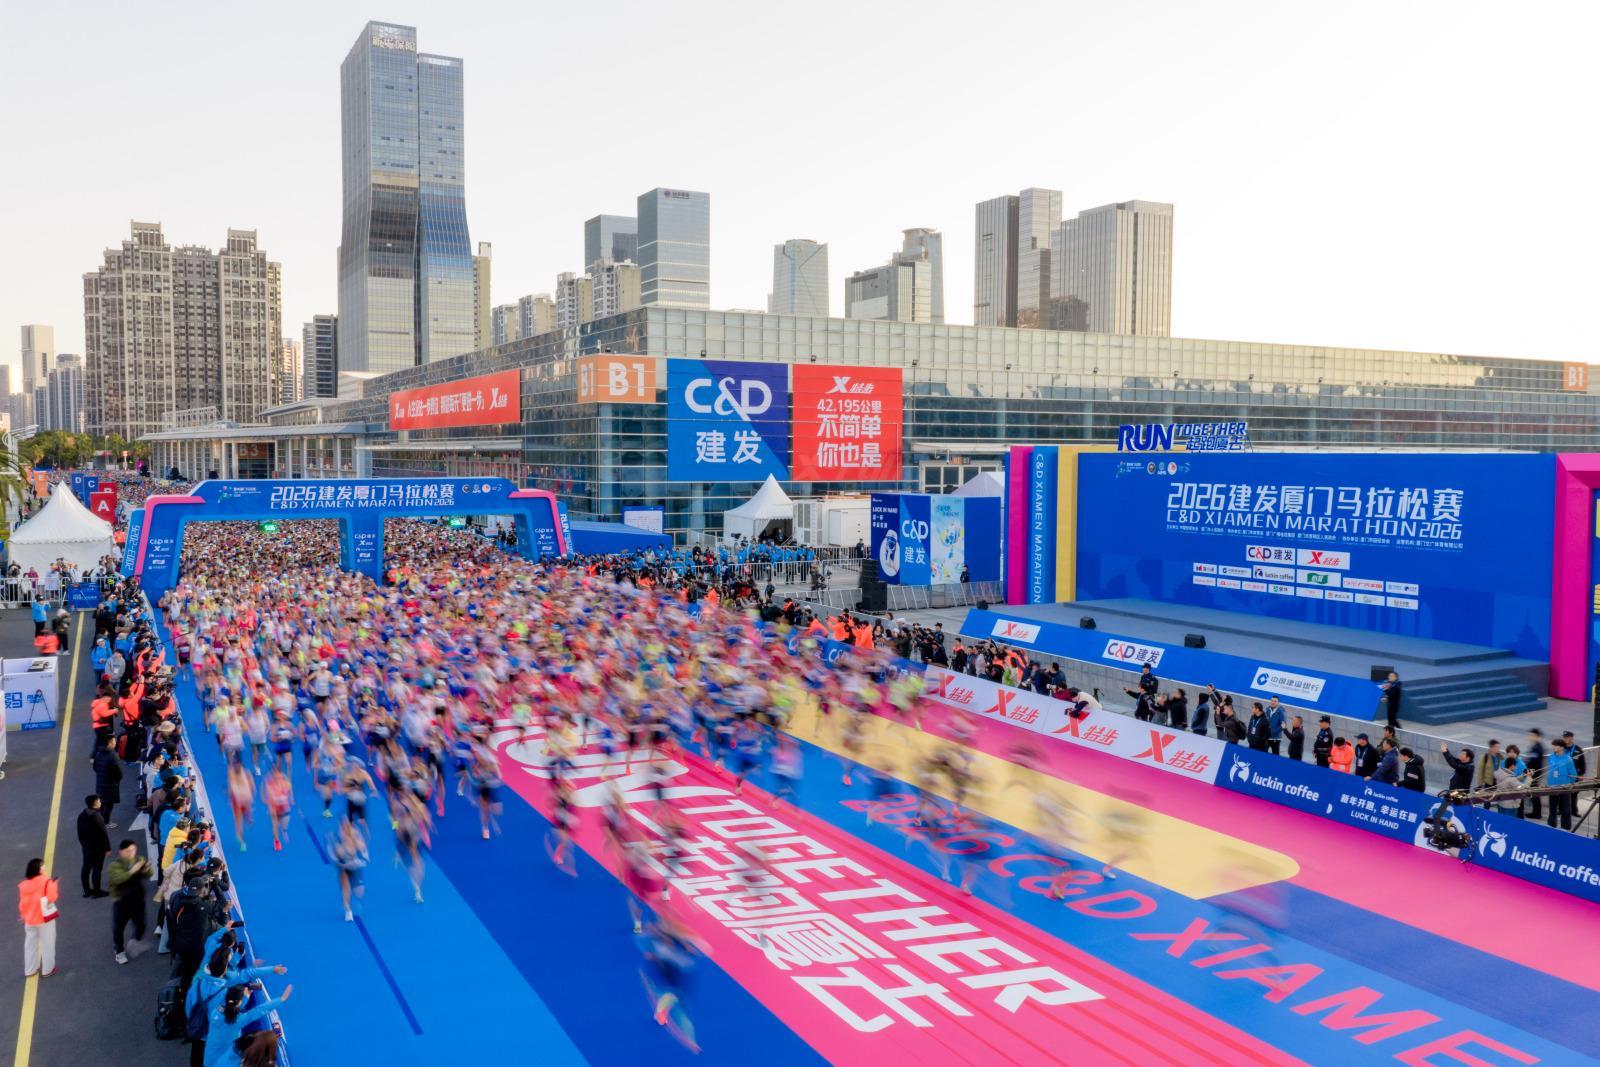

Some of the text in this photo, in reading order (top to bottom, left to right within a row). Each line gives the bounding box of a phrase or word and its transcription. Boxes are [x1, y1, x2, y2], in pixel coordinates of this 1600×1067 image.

[581, 363, 594, 397] B1
[609, 362, 645, 397] B1
[1568, 366, 1583, 387] B1
[685, 377, 772, 421] C&D
[817, 399, 882, 414] 42.195公里
[817, 414, 881, 438] 不简单
[1118, 422, 1246, 451] RUN TOGETHER
[696, 430, 762, 464] 建发
[817, 442, 882, 468] 你也是
[88, 480, 95, 488] C
[271, 484, 455, 502] 2026建发厦门马拉松赛
[98, 500, 110, 511] A
[302, 499, 354, 509] XIAMEN
[358, 497, 433, 508] MARATHON
[434, 498, 455, 506] 2026
[1167, 482, 1464, 522] 2026建发厦门马拉松赛
[902, 520, 928, 543] C&D
[1033, 453, 1044, 603] C&D XIAMEN MARATHON
[1166, 509, 1463, 540] C&D XIAMEN MARATHON 2026
[904, 547, 926, 565] 建发
[1248, 547, 1294, 561] C&D 建发
[1108, 642, 1160, 664] C&D 建发
[1009, 705, 1040, 724] 特步
[1081, 724, 1119, 746] 特步
[1167, 749, 1211, 774] 特步
[1252, 772, 1320, 802] luckin coffee
[1350, 810, 1399, 830] LUCK IN HAND
[1511, 846, 1600, 888] luckin coffe
[987, 854, 1161, 920] C&D
[679, 798, 1107, 1014] TOGETHER
